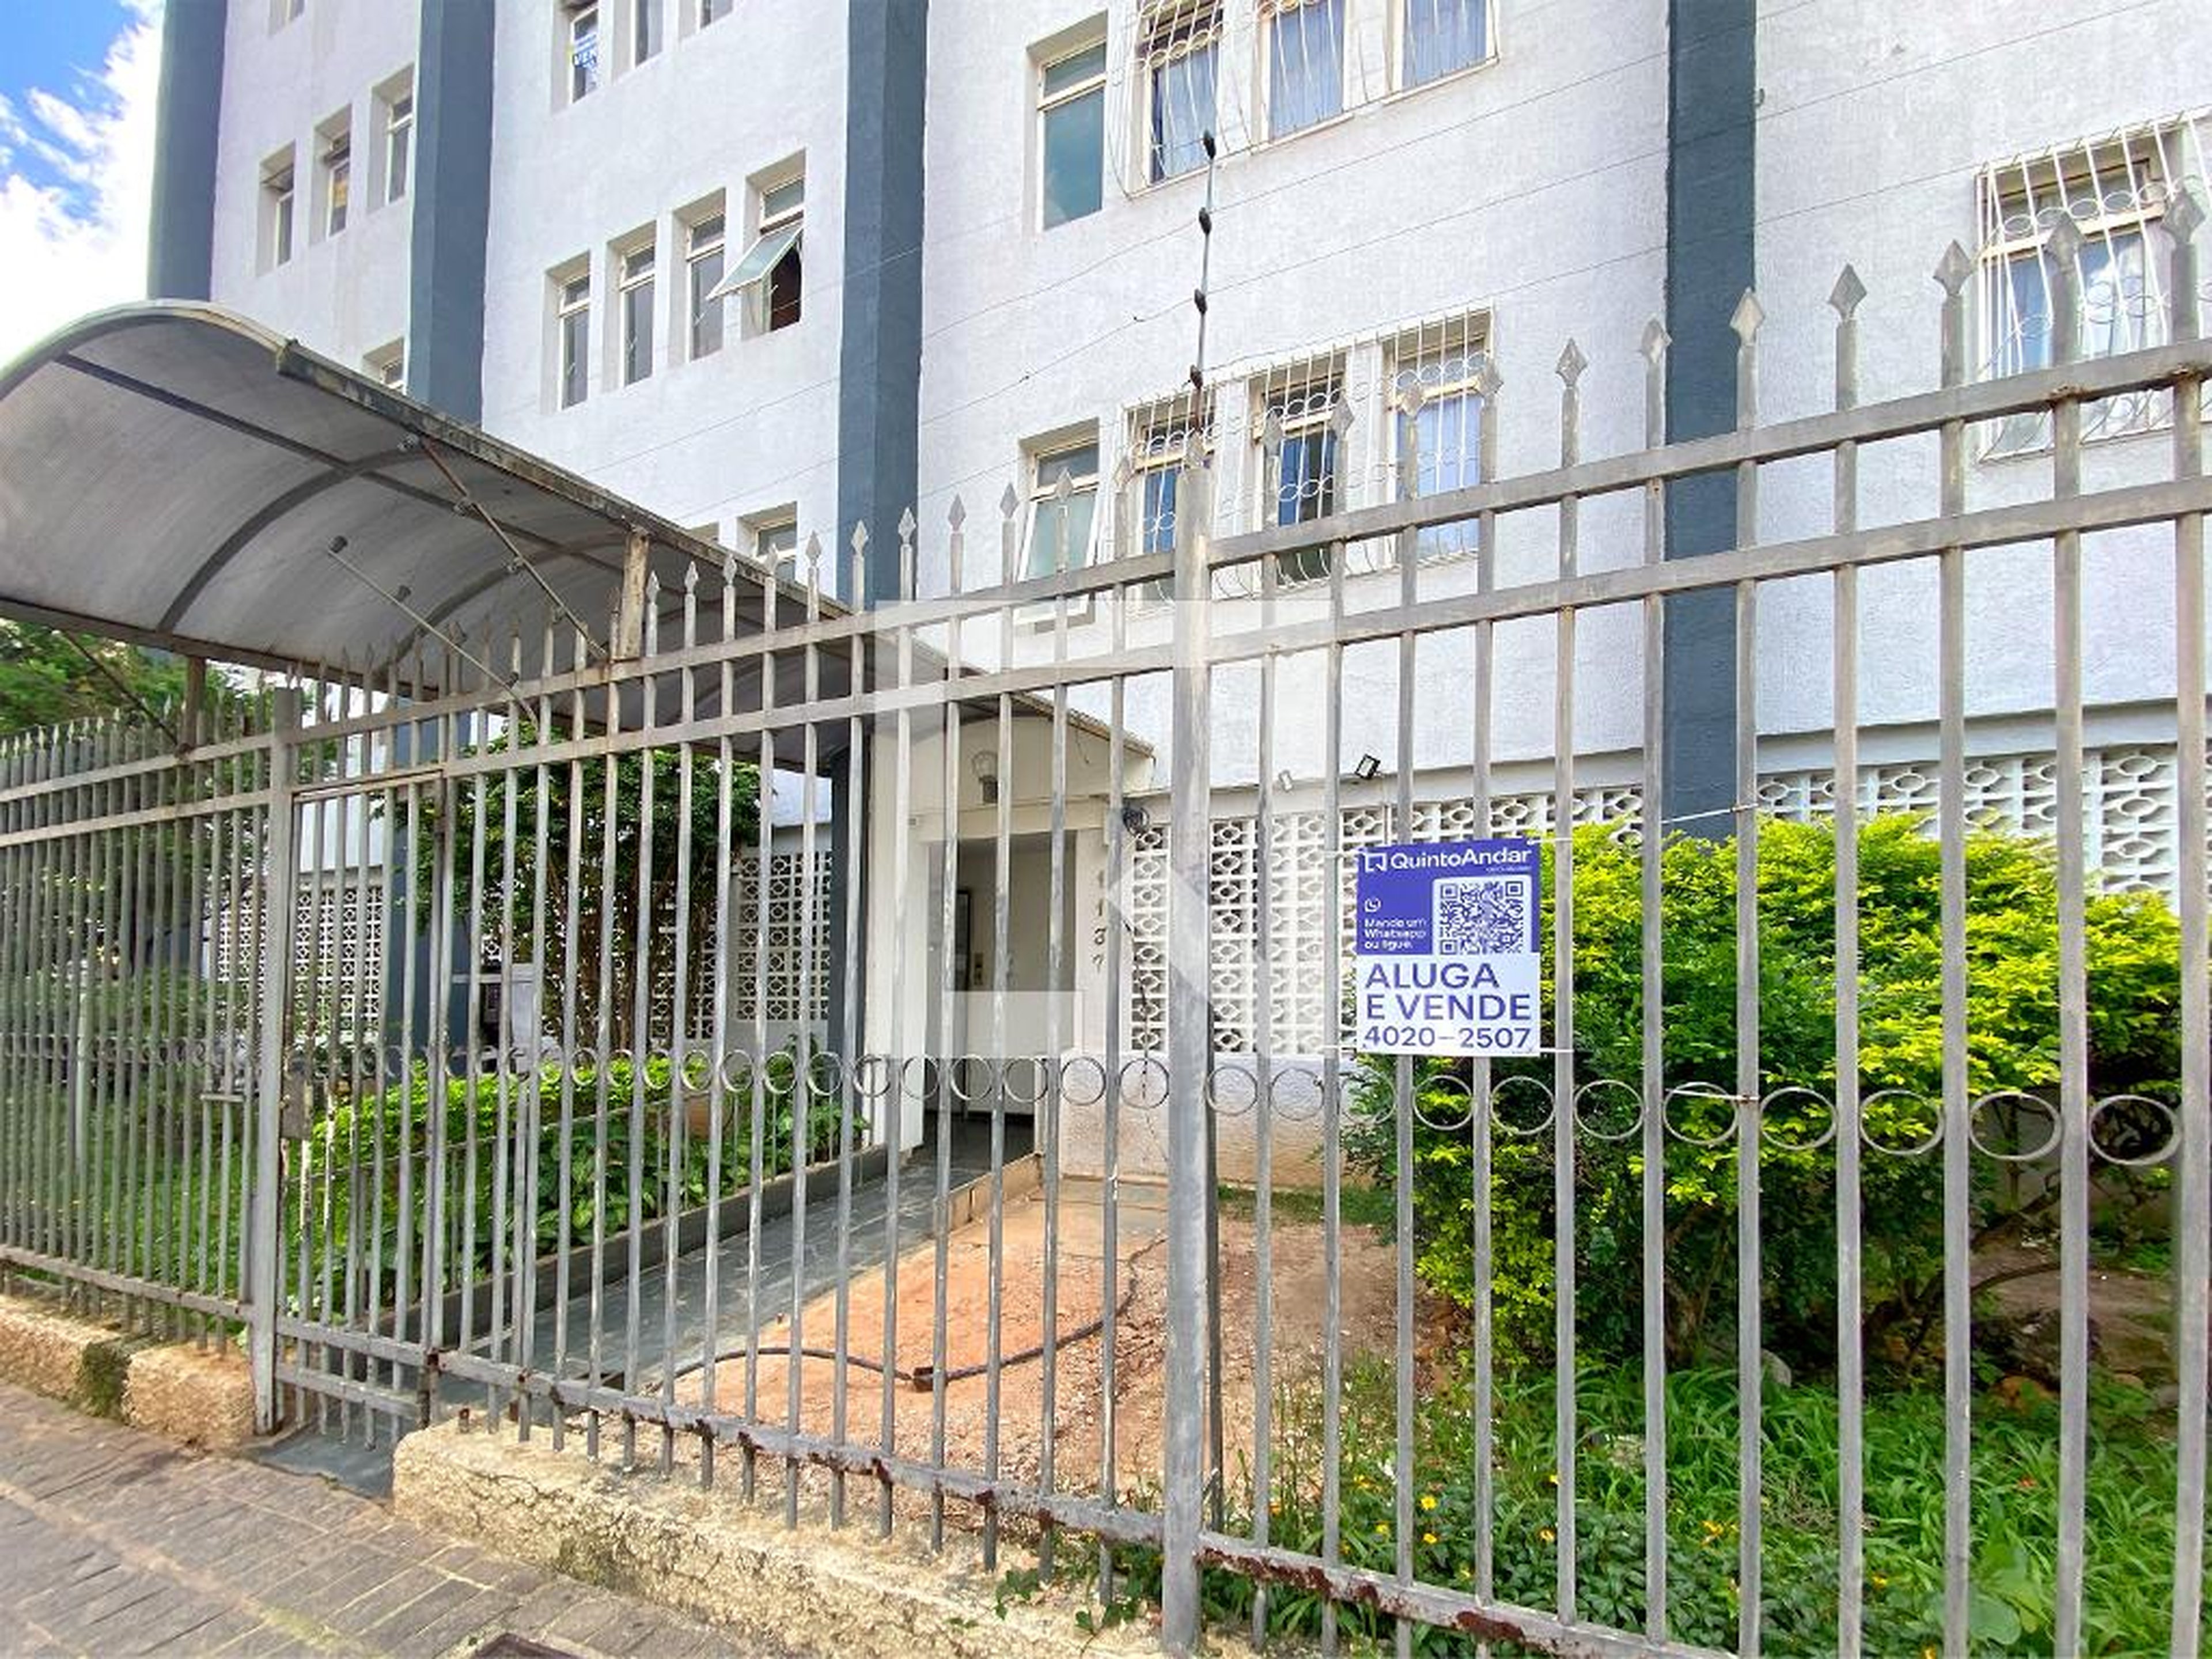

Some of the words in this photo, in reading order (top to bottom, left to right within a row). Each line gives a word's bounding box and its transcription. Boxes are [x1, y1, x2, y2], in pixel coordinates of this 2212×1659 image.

[1390, 847, 1532, 870] QuintoAndar
[1365, 963, 1500, 989] ALUGA
[1367, 994, 1385, 1020] E
[1396, 994, 1531, 1021] VENDE
